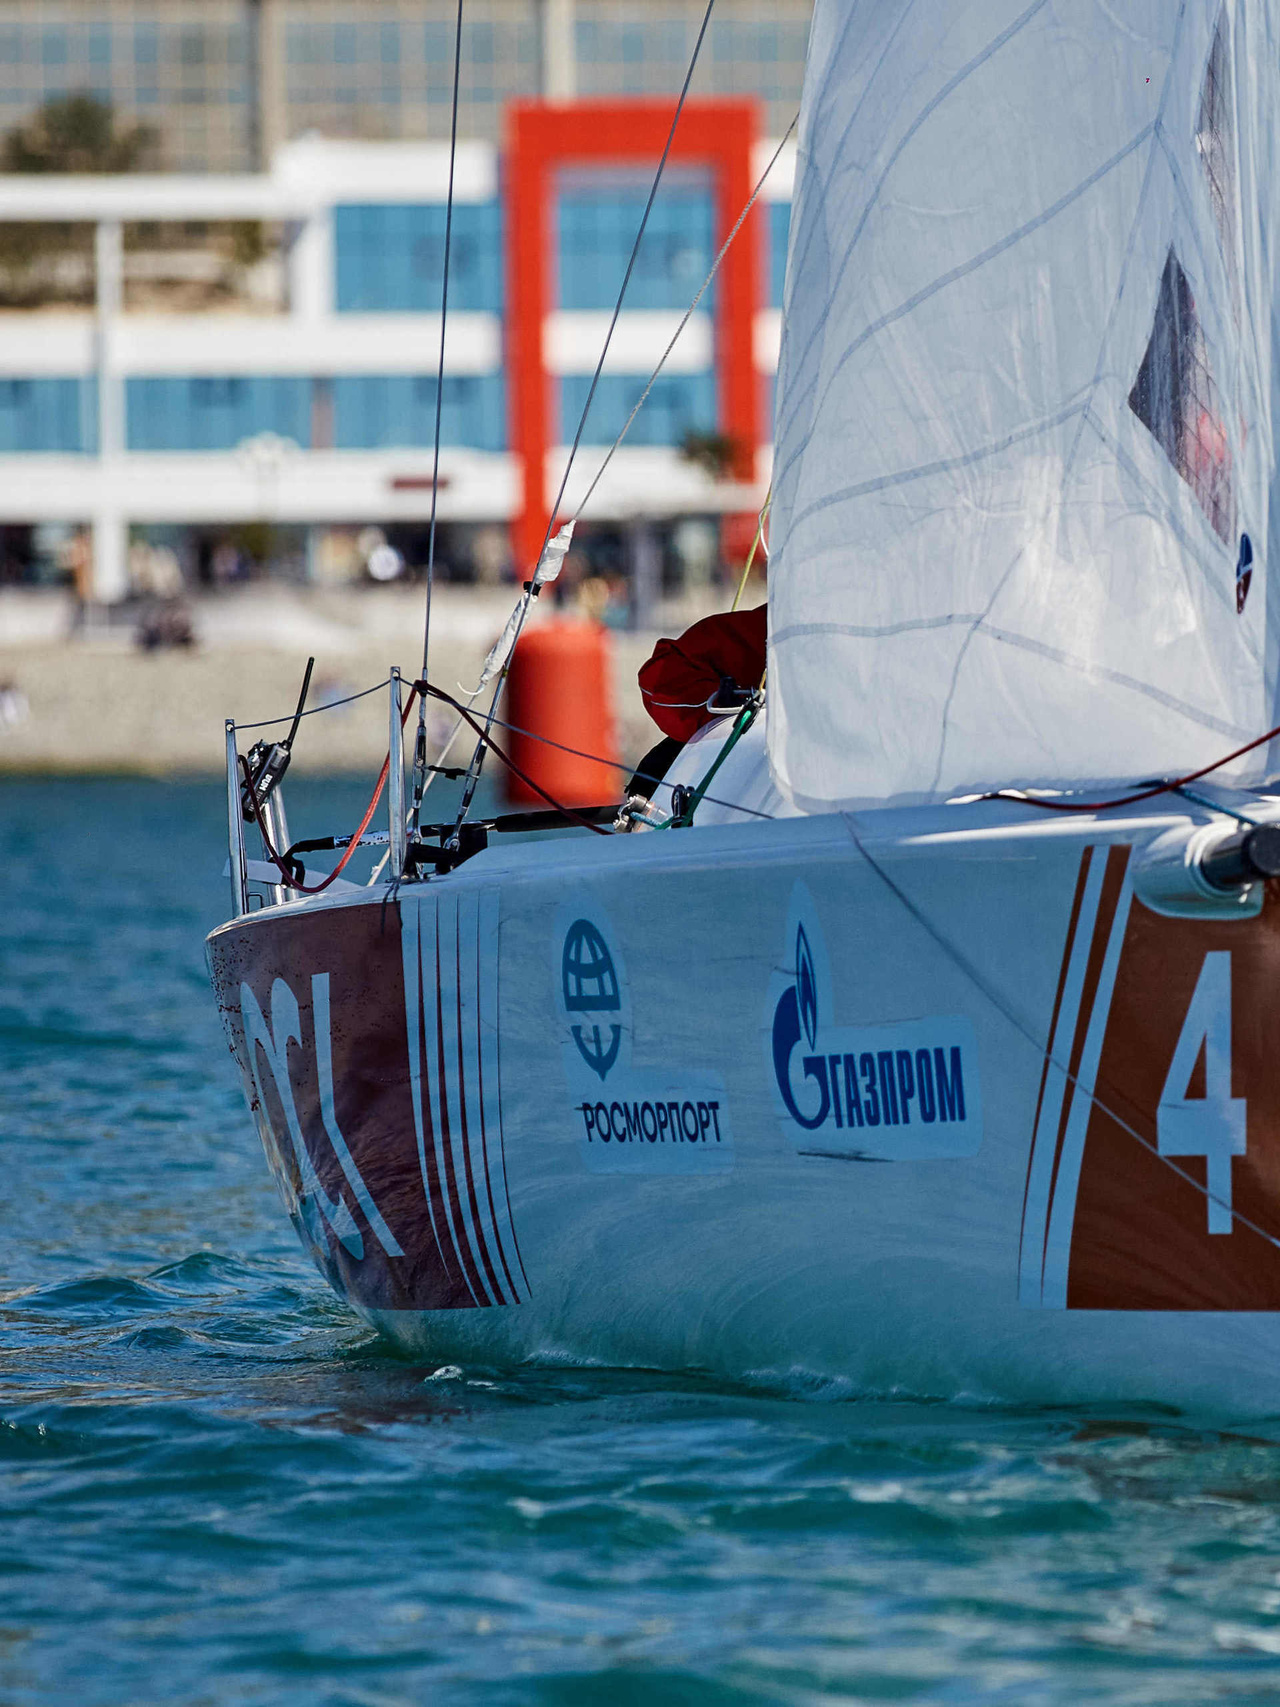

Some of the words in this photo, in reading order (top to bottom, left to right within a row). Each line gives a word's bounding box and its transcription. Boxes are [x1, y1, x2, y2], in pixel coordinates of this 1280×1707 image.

[580, 1101, 721, 1143] РОСМОРПОРТ
[828, 1045, 967, 1129] ГАЗПРОМ
[1157, 950, 1247, 1235] 4
